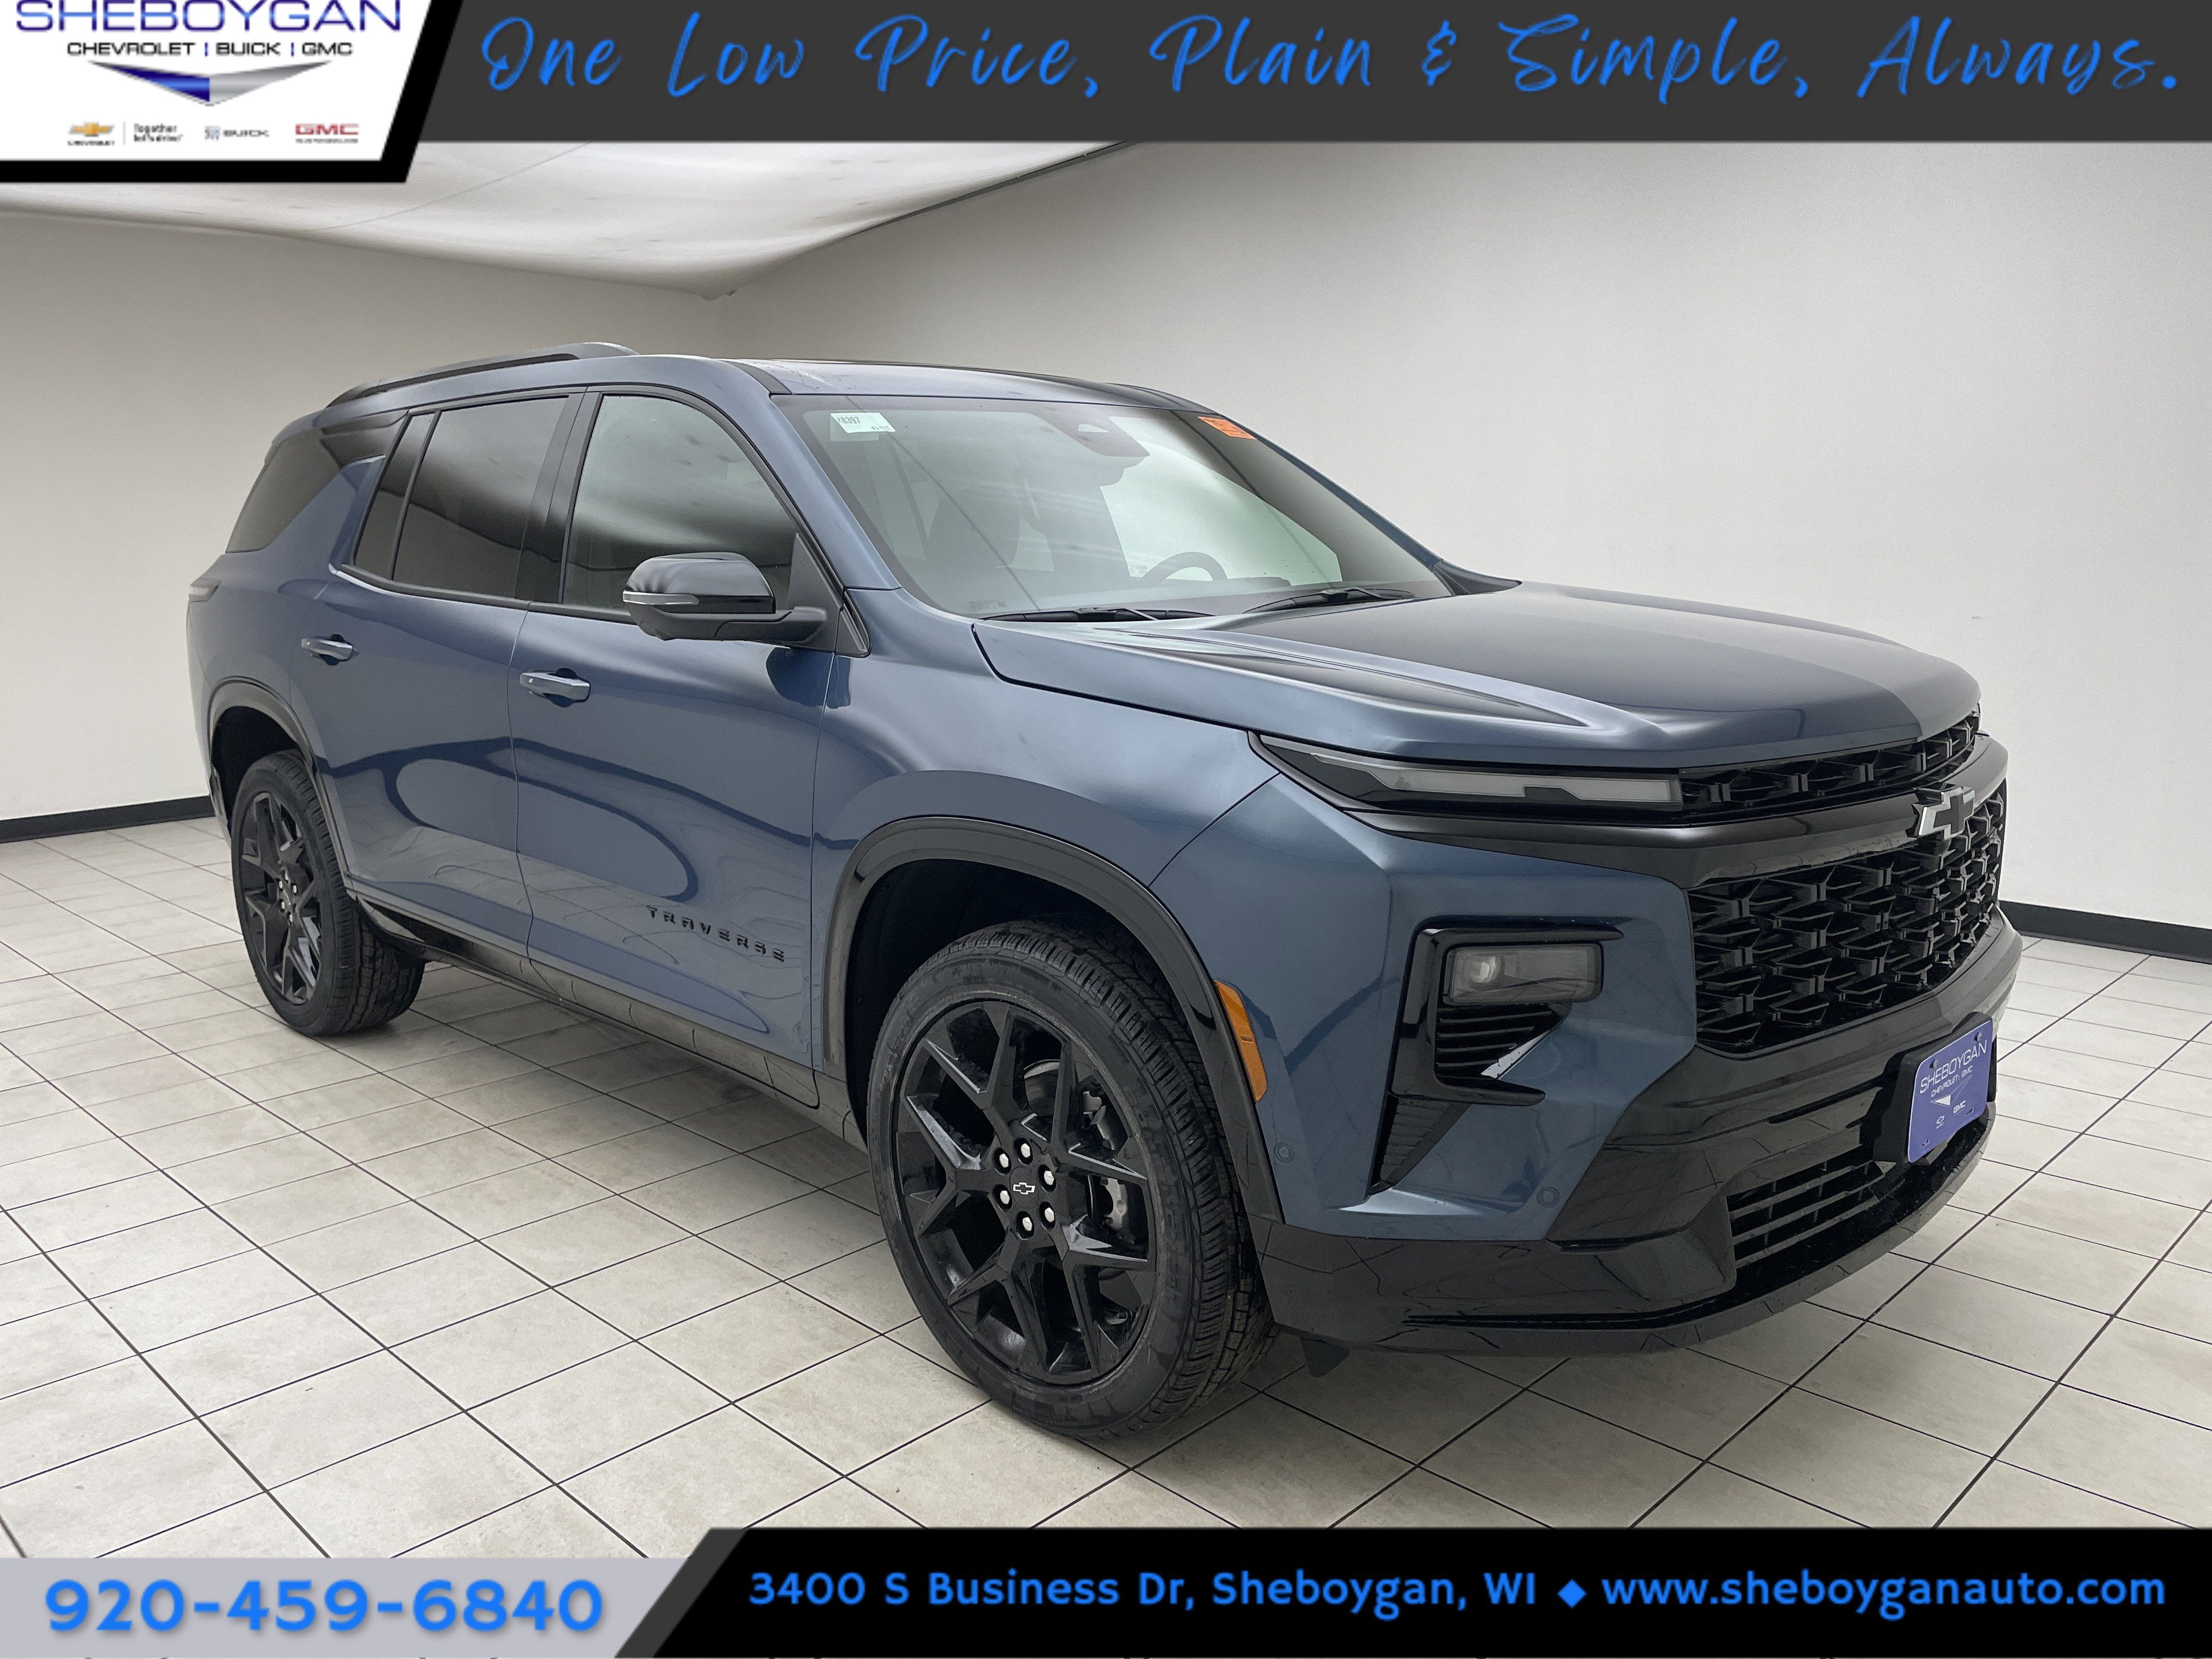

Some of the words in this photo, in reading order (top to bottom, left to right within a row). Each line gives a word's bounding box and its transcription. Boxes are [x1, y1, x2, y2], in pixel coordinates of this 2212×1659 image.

[645, 905, 785, 962] TRAVERSE
[1920, 1040, 1987, 1094] SHEBOYGAN
[1931, 1074, 1959, 1097] CHEVROLET
[1961, 1065, 1973, 1078] GMC
[1953, 1100, 1966, 1114] GMC
